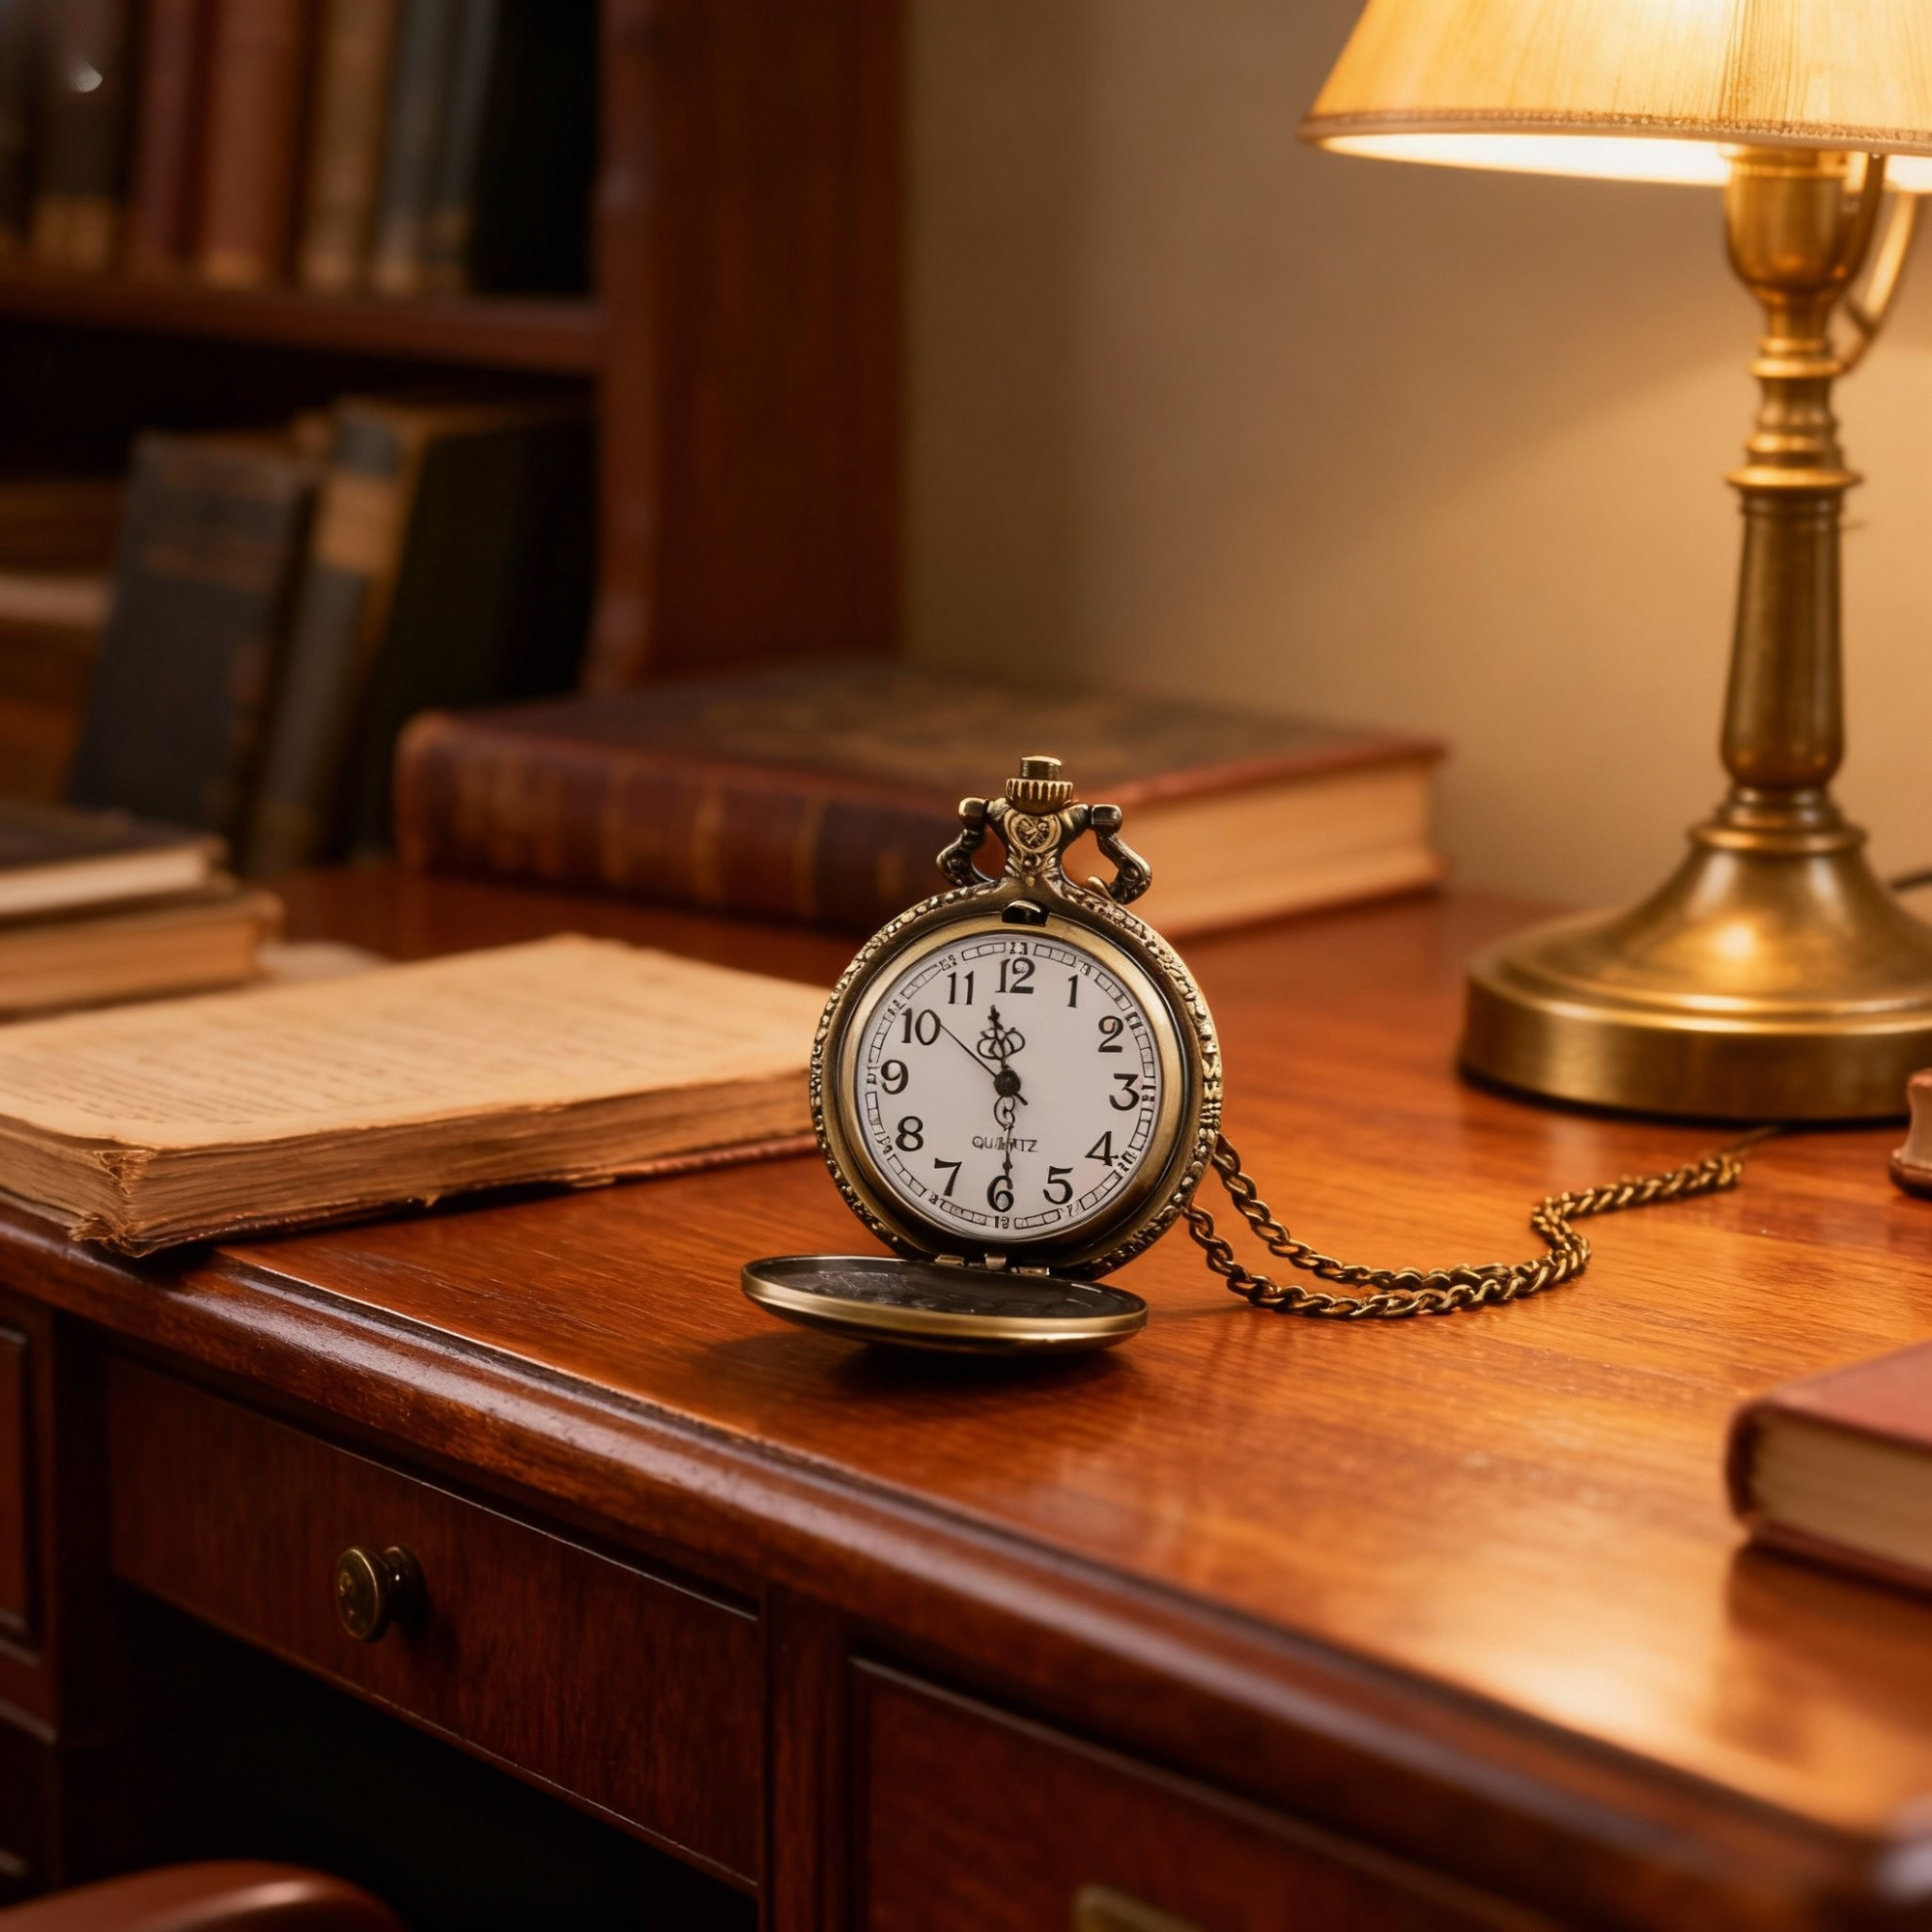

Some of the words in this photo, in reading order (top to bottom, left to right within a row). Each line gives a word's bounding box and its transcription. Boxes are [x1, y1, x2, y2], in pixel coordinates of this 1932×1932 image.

[947, 972, 974, 1005] 11
[995, 956, 1036, 994] 12
[1067, 975, 1078, 1008] 1
[900, 1007, 941, 1045] 10
[1098, 1015, 1124, 1053] 2
[880, 1060, 909, 1094] 9
[1109, 1073, 1140, 1111] 3
[895, 1116, 924, 1151] 8
[972, 1135, 1038, 1152] QUTZ
[1085, 1131, 1119, 1167] 4
[934, 1158, 962, 1197] 7
[987, 1175, 1014, 1212] 6
[1043, 1166, 1073, 1205] 5
